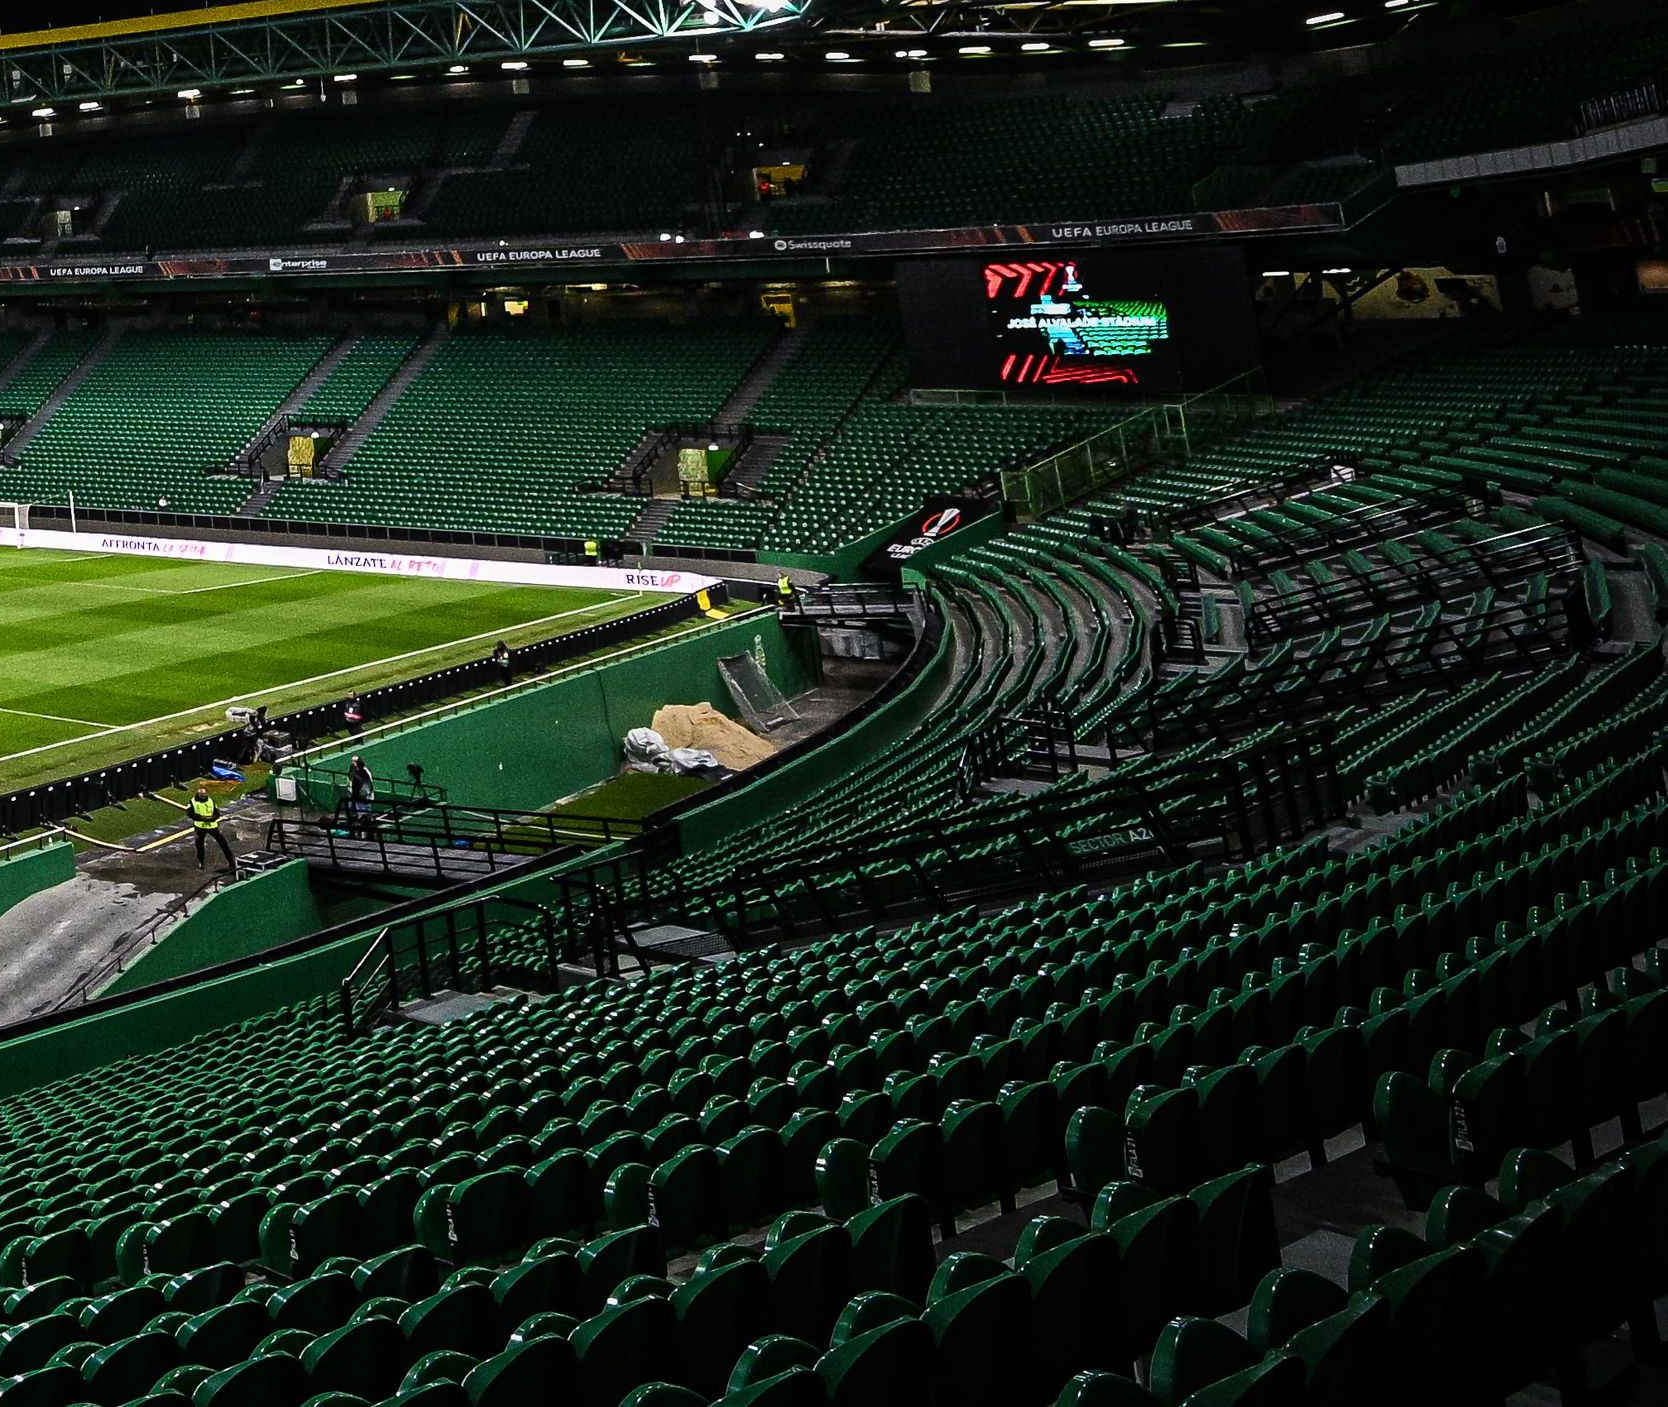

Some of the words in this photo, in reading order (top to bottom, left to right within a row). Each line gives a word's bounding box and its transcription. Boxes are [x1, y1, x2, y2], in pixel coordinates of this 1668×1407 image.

[1052, 227, 1092, 238] UEFA
[1095, 224, 1142, 236] EUROPA
[1145, 220, 1193, 233] LEAGUE
[477, 252, 507, 261] UEFA
[509, 251, 553, 260] EUROPA
[555, 249, 601, 259] LEAGUE
[50, 268, 73, 276] UEFA
[74, 267, 108, 275] EUROPA
[109, 266, 143, 274] LEAGUE
[625, 574, 659, 586] RISE
[1068, 832, 1126, 854] SECTOR
[1128, 827, 1155, 842] A2
[1128, 1149, 1139, 1168] FILA
